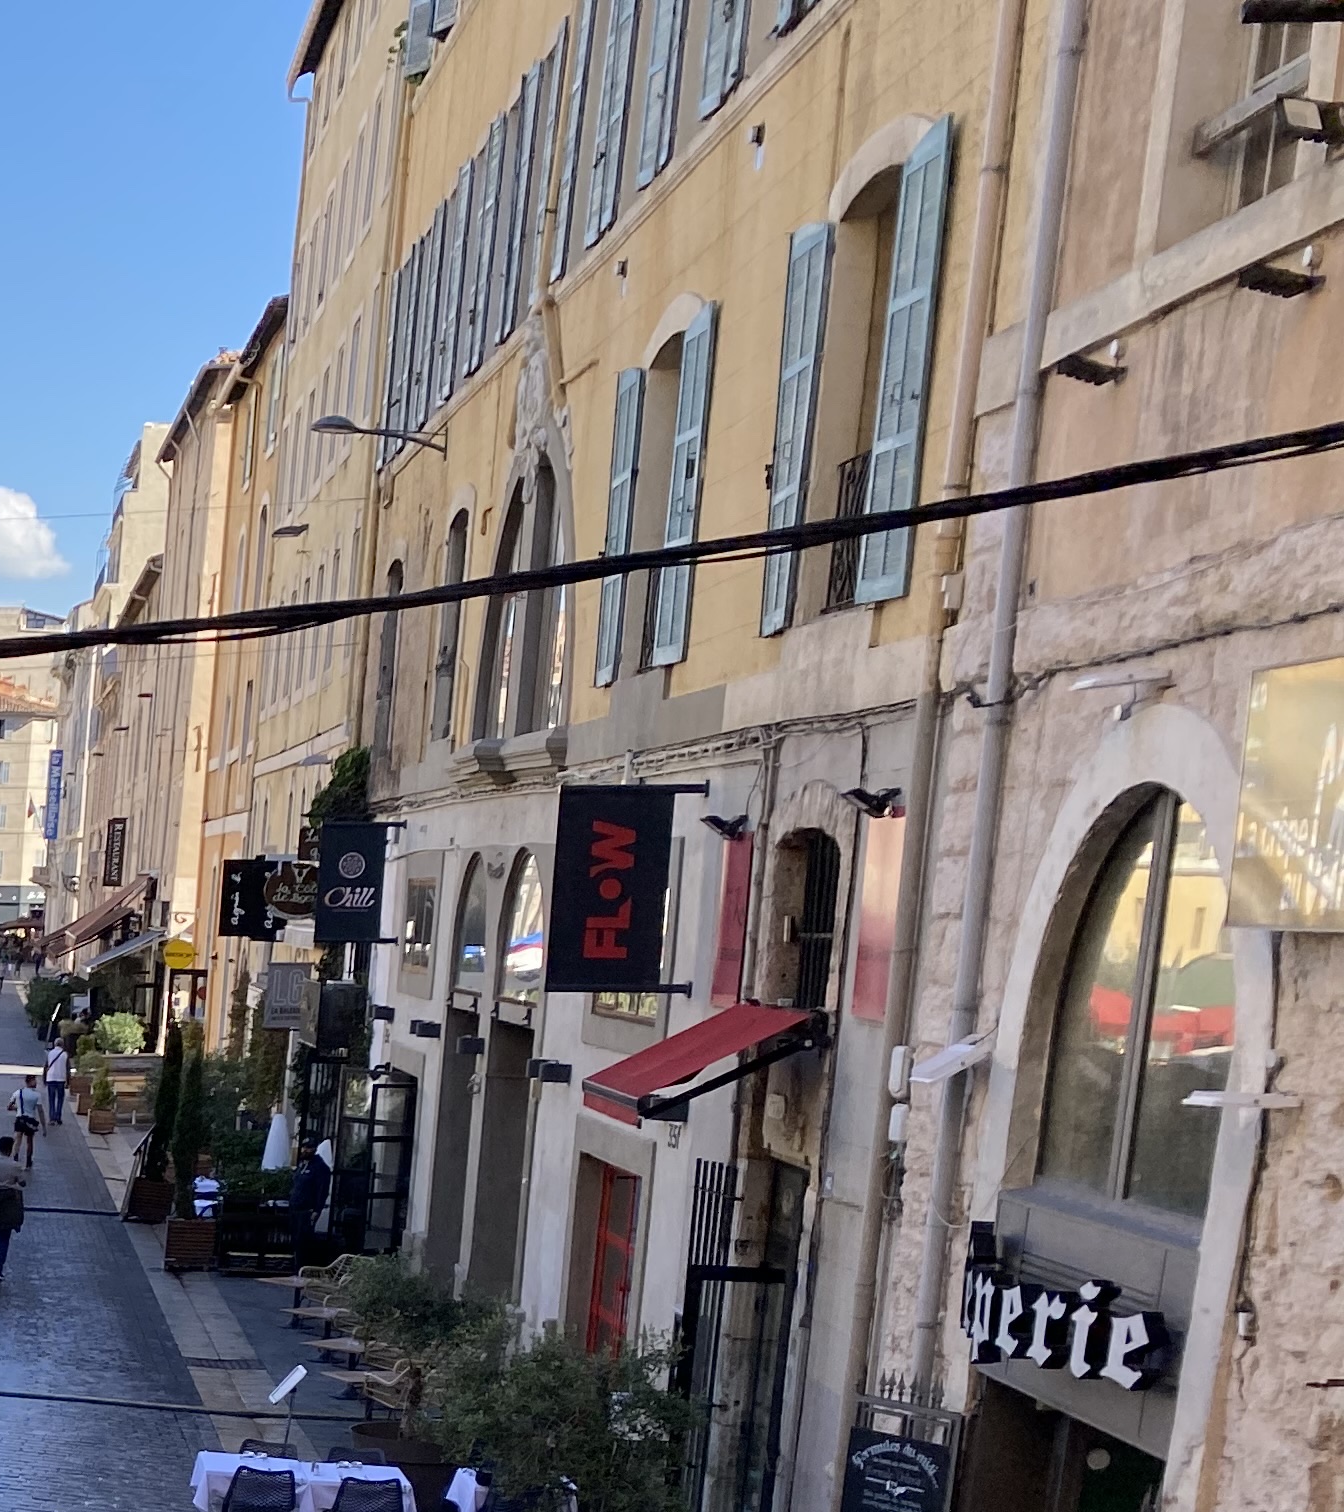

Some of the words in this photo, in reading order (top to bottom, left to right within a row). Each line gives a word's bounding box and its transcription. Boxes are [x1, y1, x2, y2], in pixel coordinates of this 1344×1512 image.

[110, 823, 124, 881] RESTAURANT
[324, 886, 376, 908] Chill
[582, 820, 637, 959] FLOW
